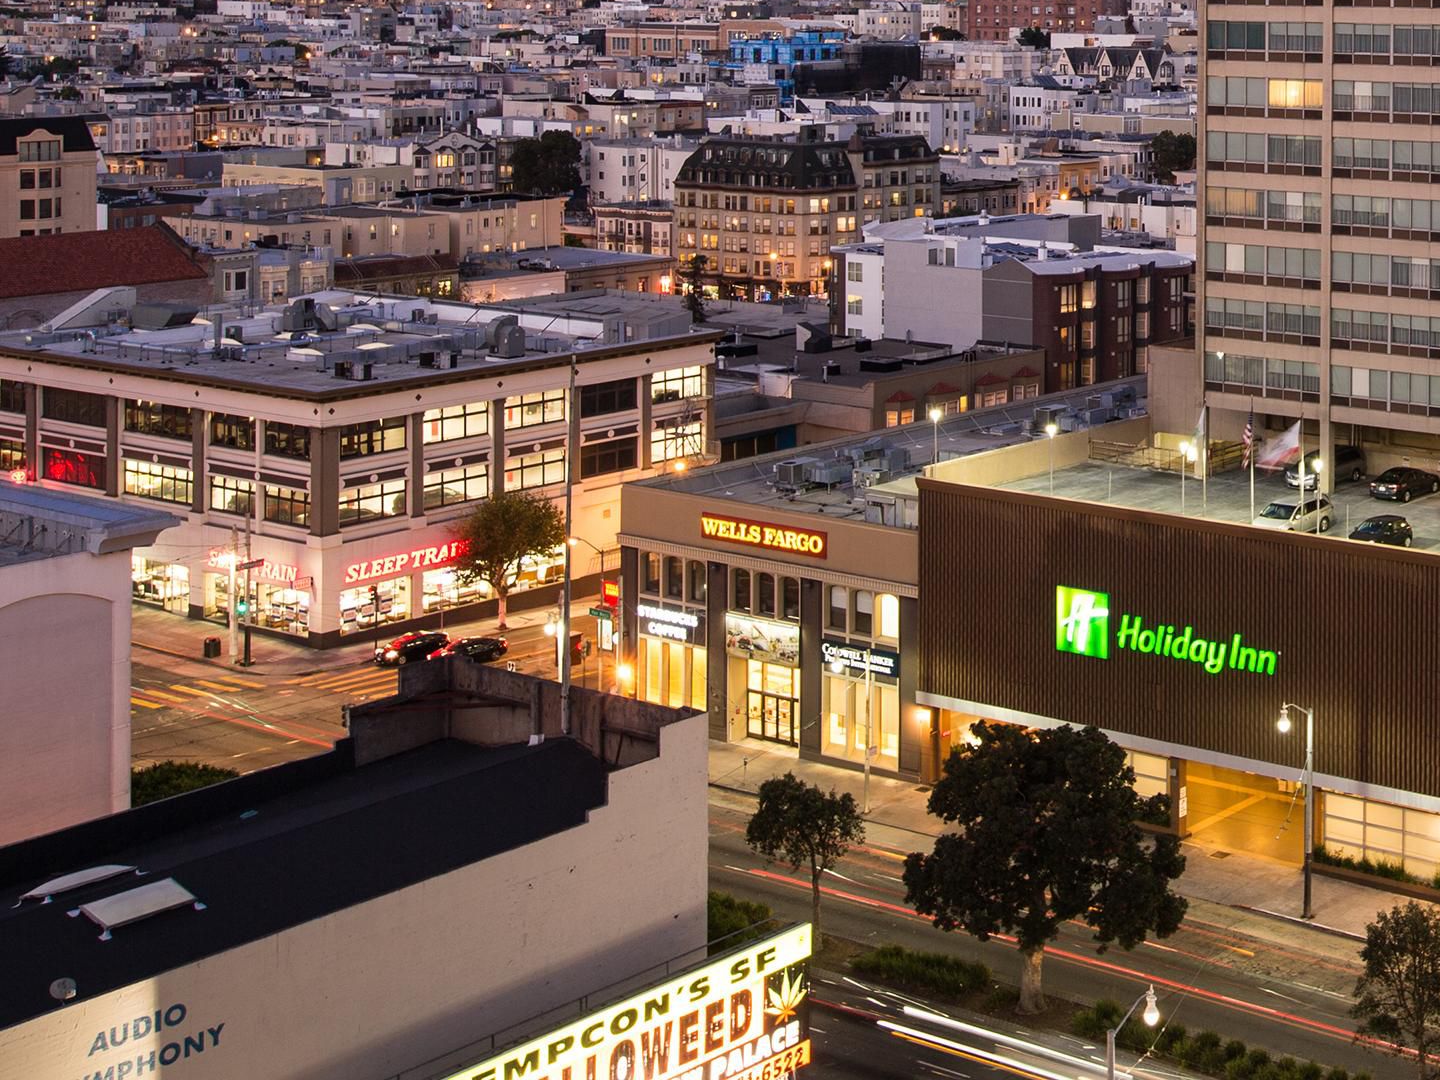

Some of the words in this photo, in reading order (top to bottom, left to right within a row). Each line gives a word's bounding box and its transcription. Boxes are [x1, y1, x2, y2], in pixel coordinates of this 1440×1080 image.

[702, 517, 762, 544] WELLS
[763, 527, 824, 554] FARGO
[345, 554, 409, 583] SLEEP
[410, 540, 471, 569] TRAI
[1116, 614, 1227, 674] Holiday
[1229, 633, 1277, 676] Inn
[730, 946, 777, 985] SF
[88, 1003, 187, 1058] AUDIO
[710, 1019, 800, 1080] PALACE
